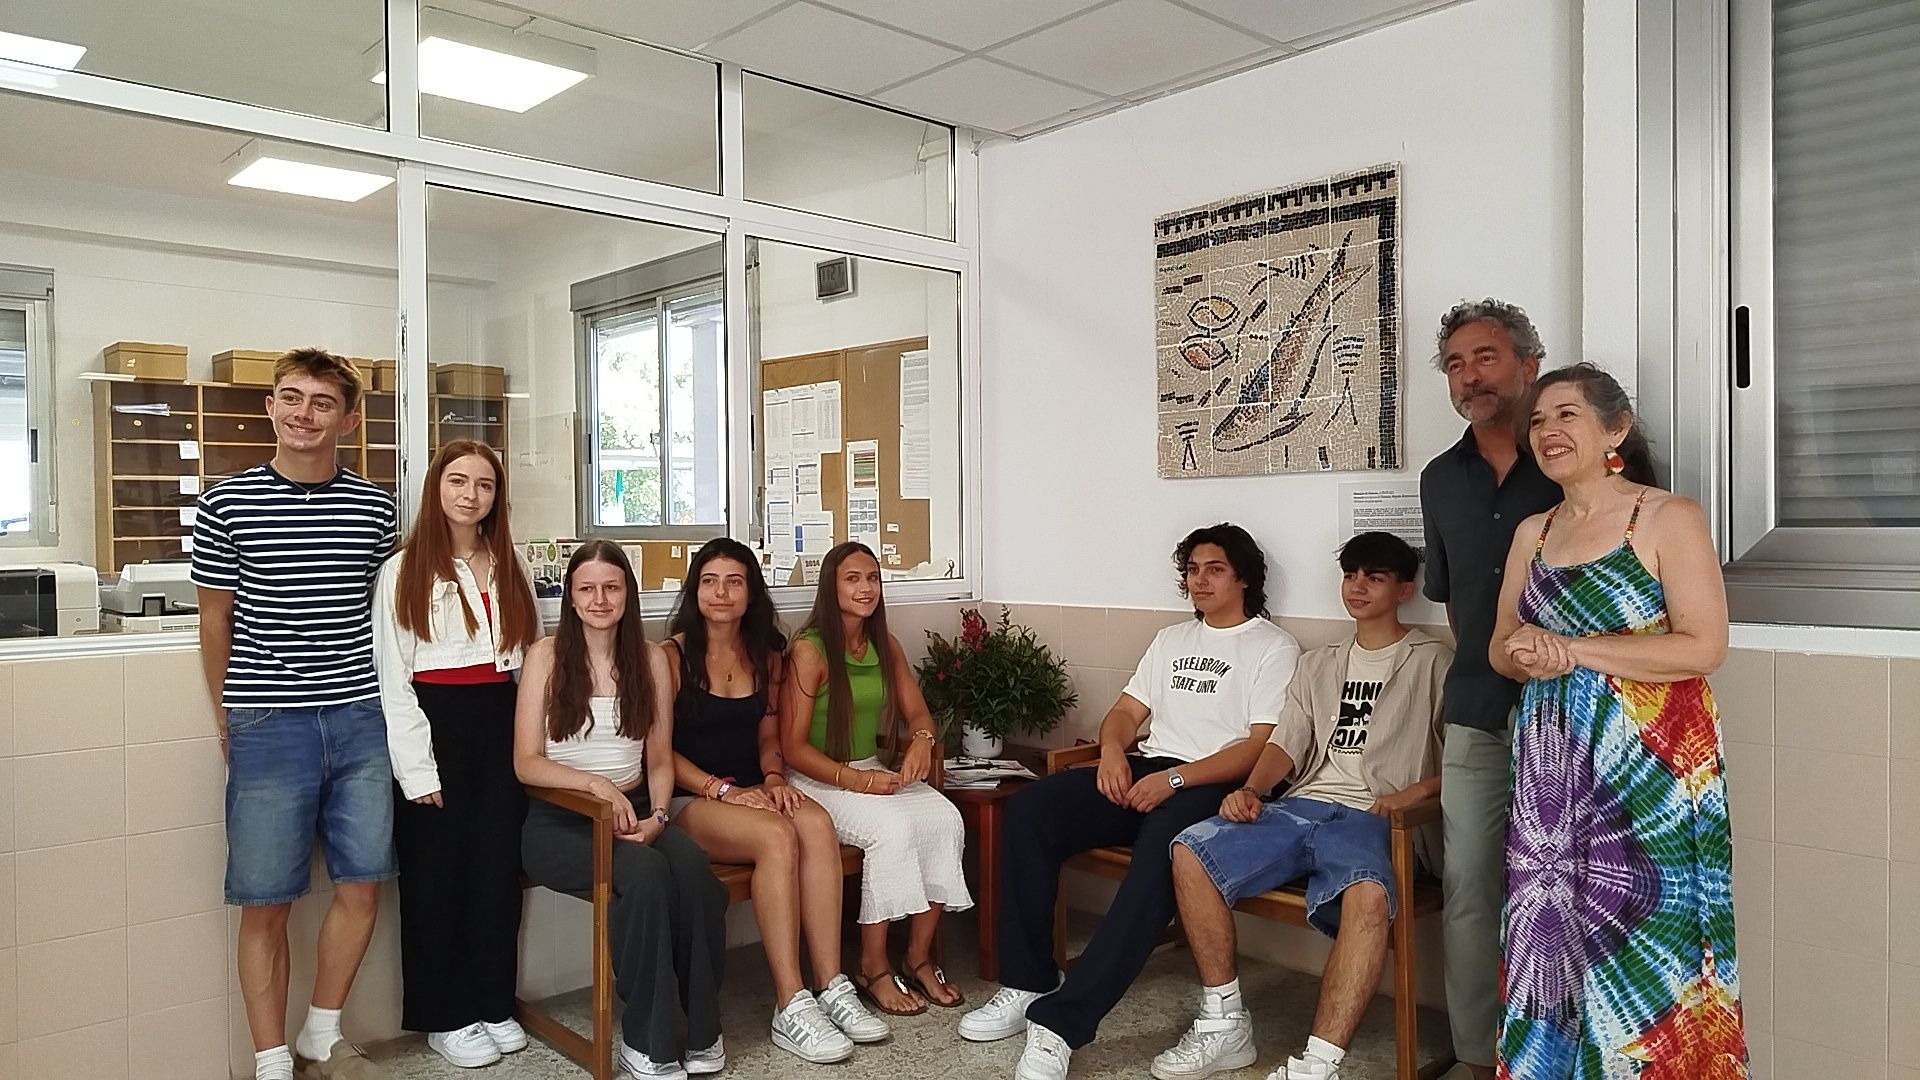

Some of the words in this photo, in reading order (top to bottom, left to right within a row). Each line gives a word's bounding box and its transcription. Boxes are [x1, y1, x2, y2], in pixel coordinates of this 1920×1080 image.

[1172, 656, 1232, 678] STEELBROOK
[1170, 675, 1197, 691] STATE
[1196, 680, 1218, 693] UNIV.
